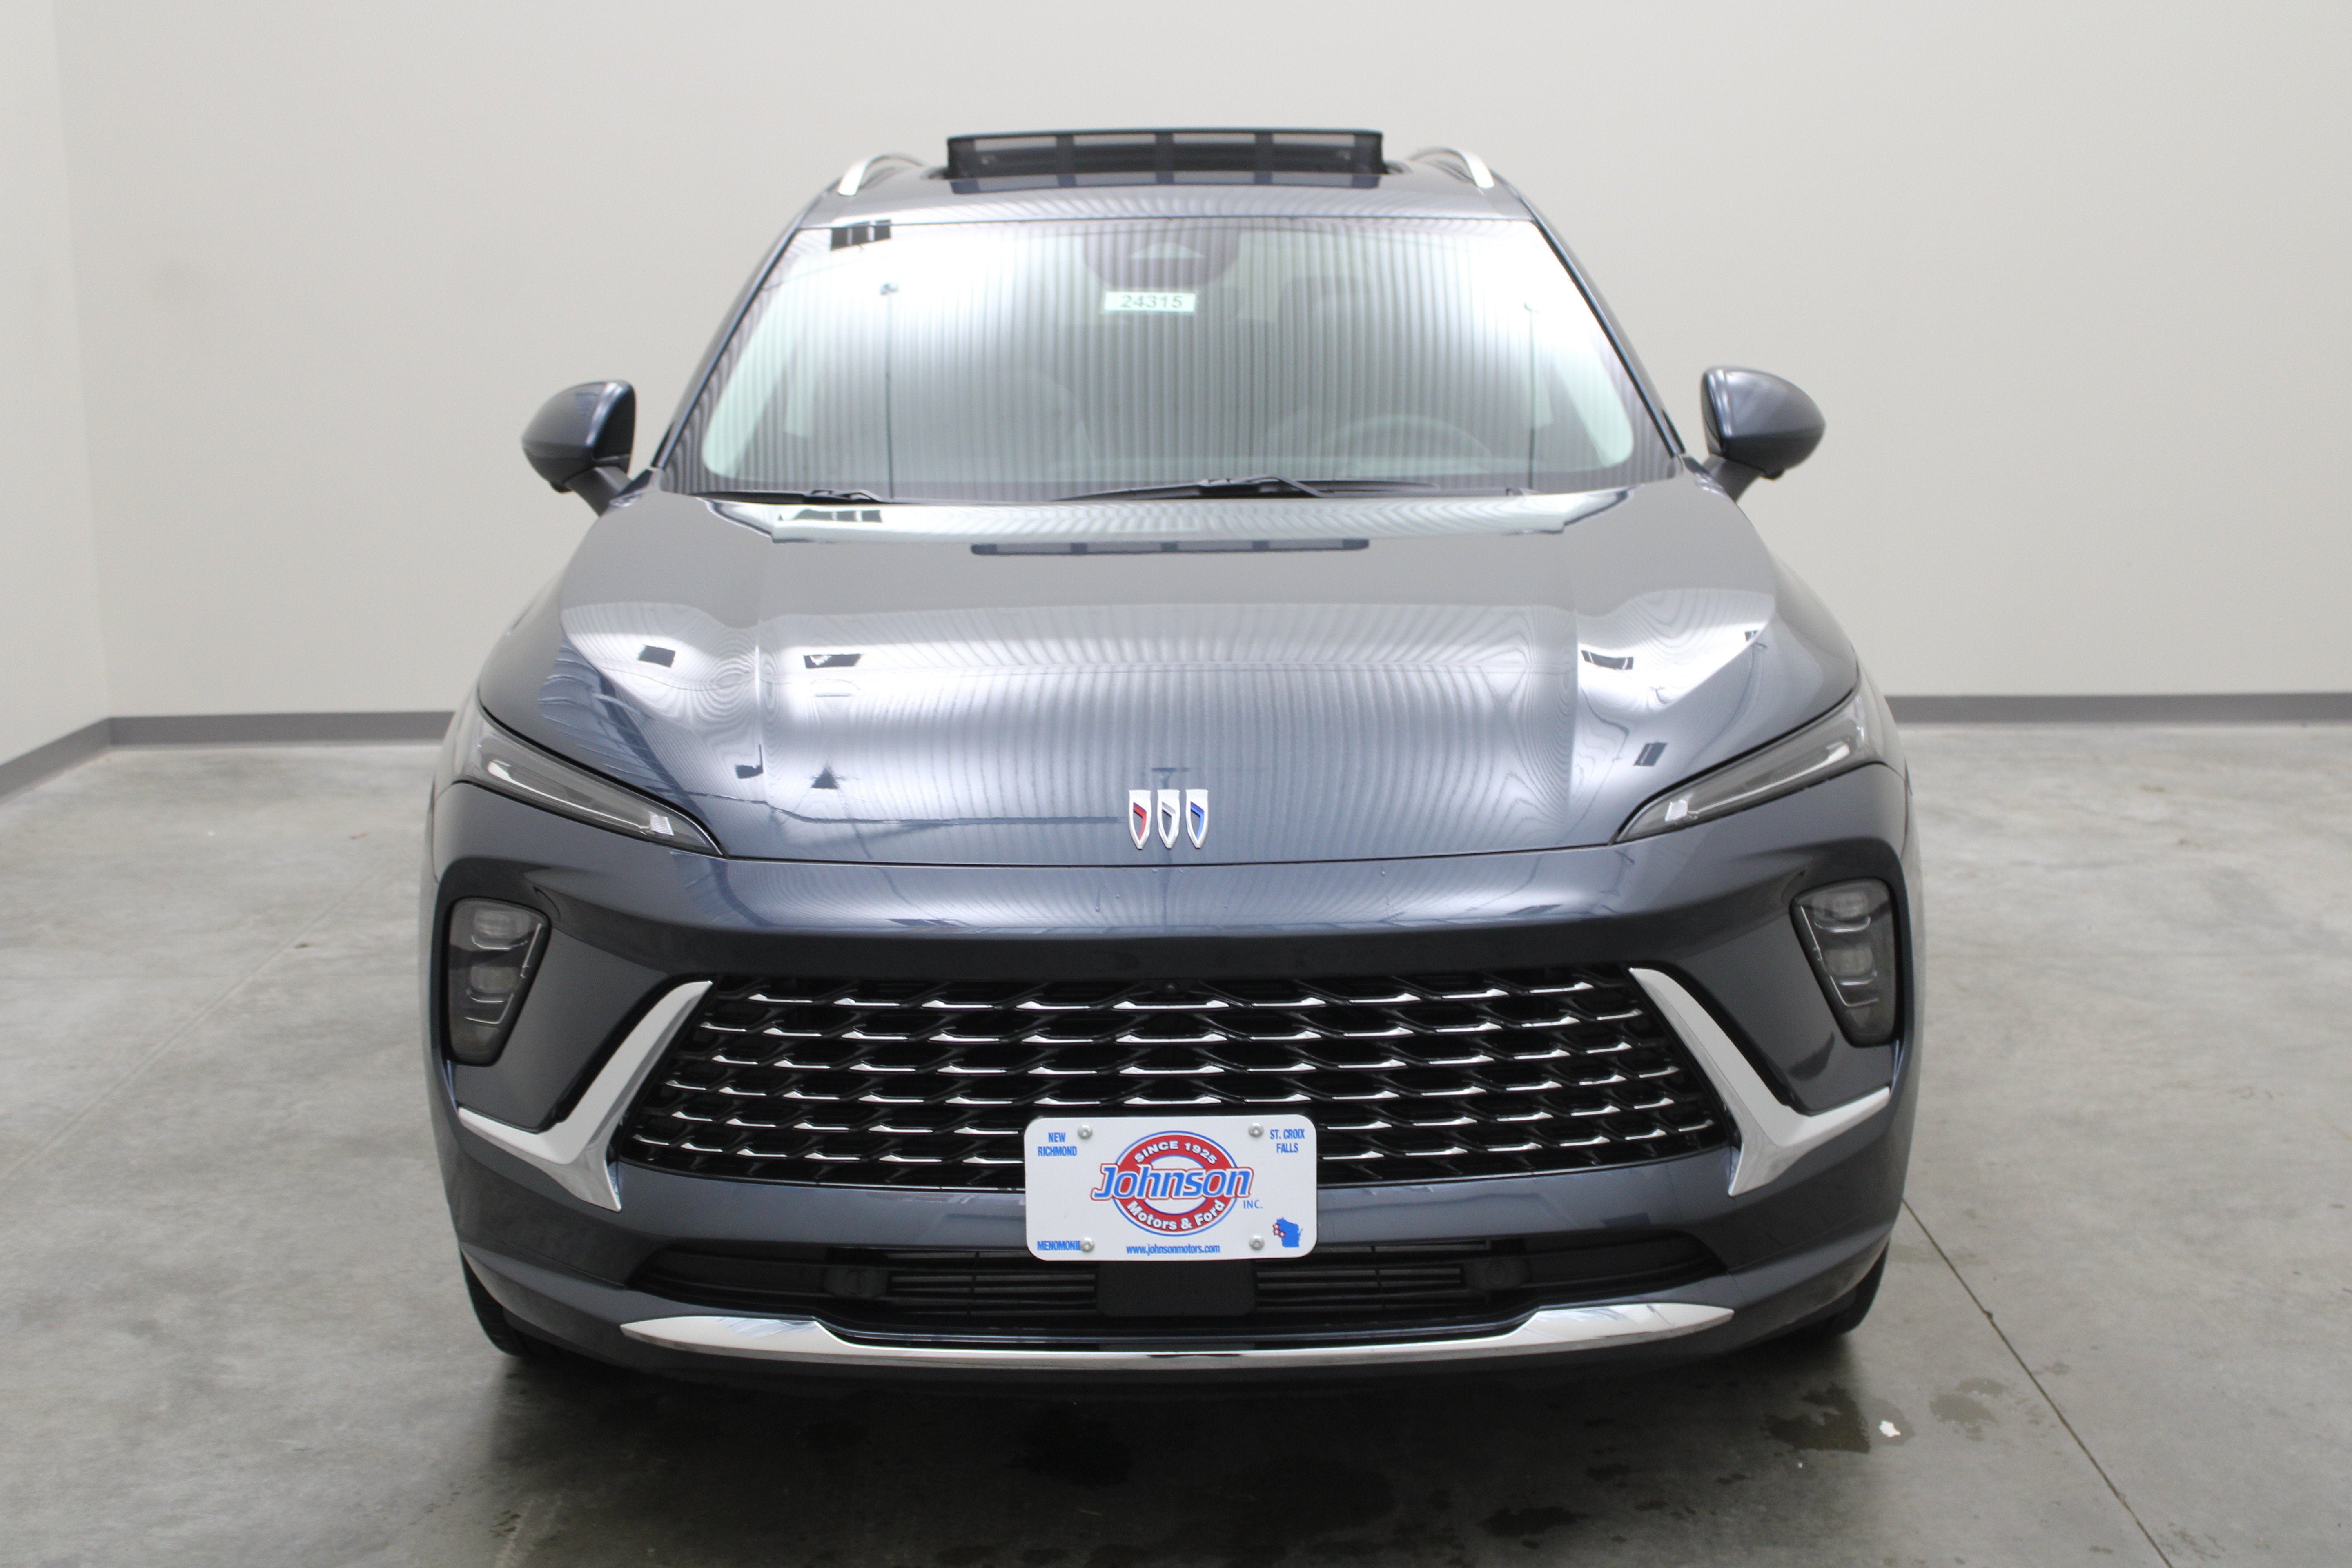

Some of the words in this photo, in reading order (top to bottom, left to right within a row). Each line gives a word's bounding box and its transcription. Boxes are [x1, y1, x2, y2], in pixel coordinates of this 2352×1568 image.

[1120, 295, 1182, 309] 24315
[1048, 1132, 1065, 1142] NEW
[1270, 1129, 1281, 1140] ST.
[1284, 1129, 1305, 1139] CROIX
[1038, 1146, 1077, 1156] RICHMOND
[1134, 1140, 1179, 1163] SINCE
[1185, 1142, 1218, 1164] 1925
[1276, 1143, 1298, 1153] FALLS
[1094, 1166, 1251, 1198] Johnson
[1243, 1200, 1263, 1209] INC.
[1126, 1200, 1178, 1230] Motors
[1180, 1217, 1193, 1230] &
[1193, 1199, 1225, 1227] Ford
[1126, 1243, 1221, 1256] www.johnsonmotors.com
